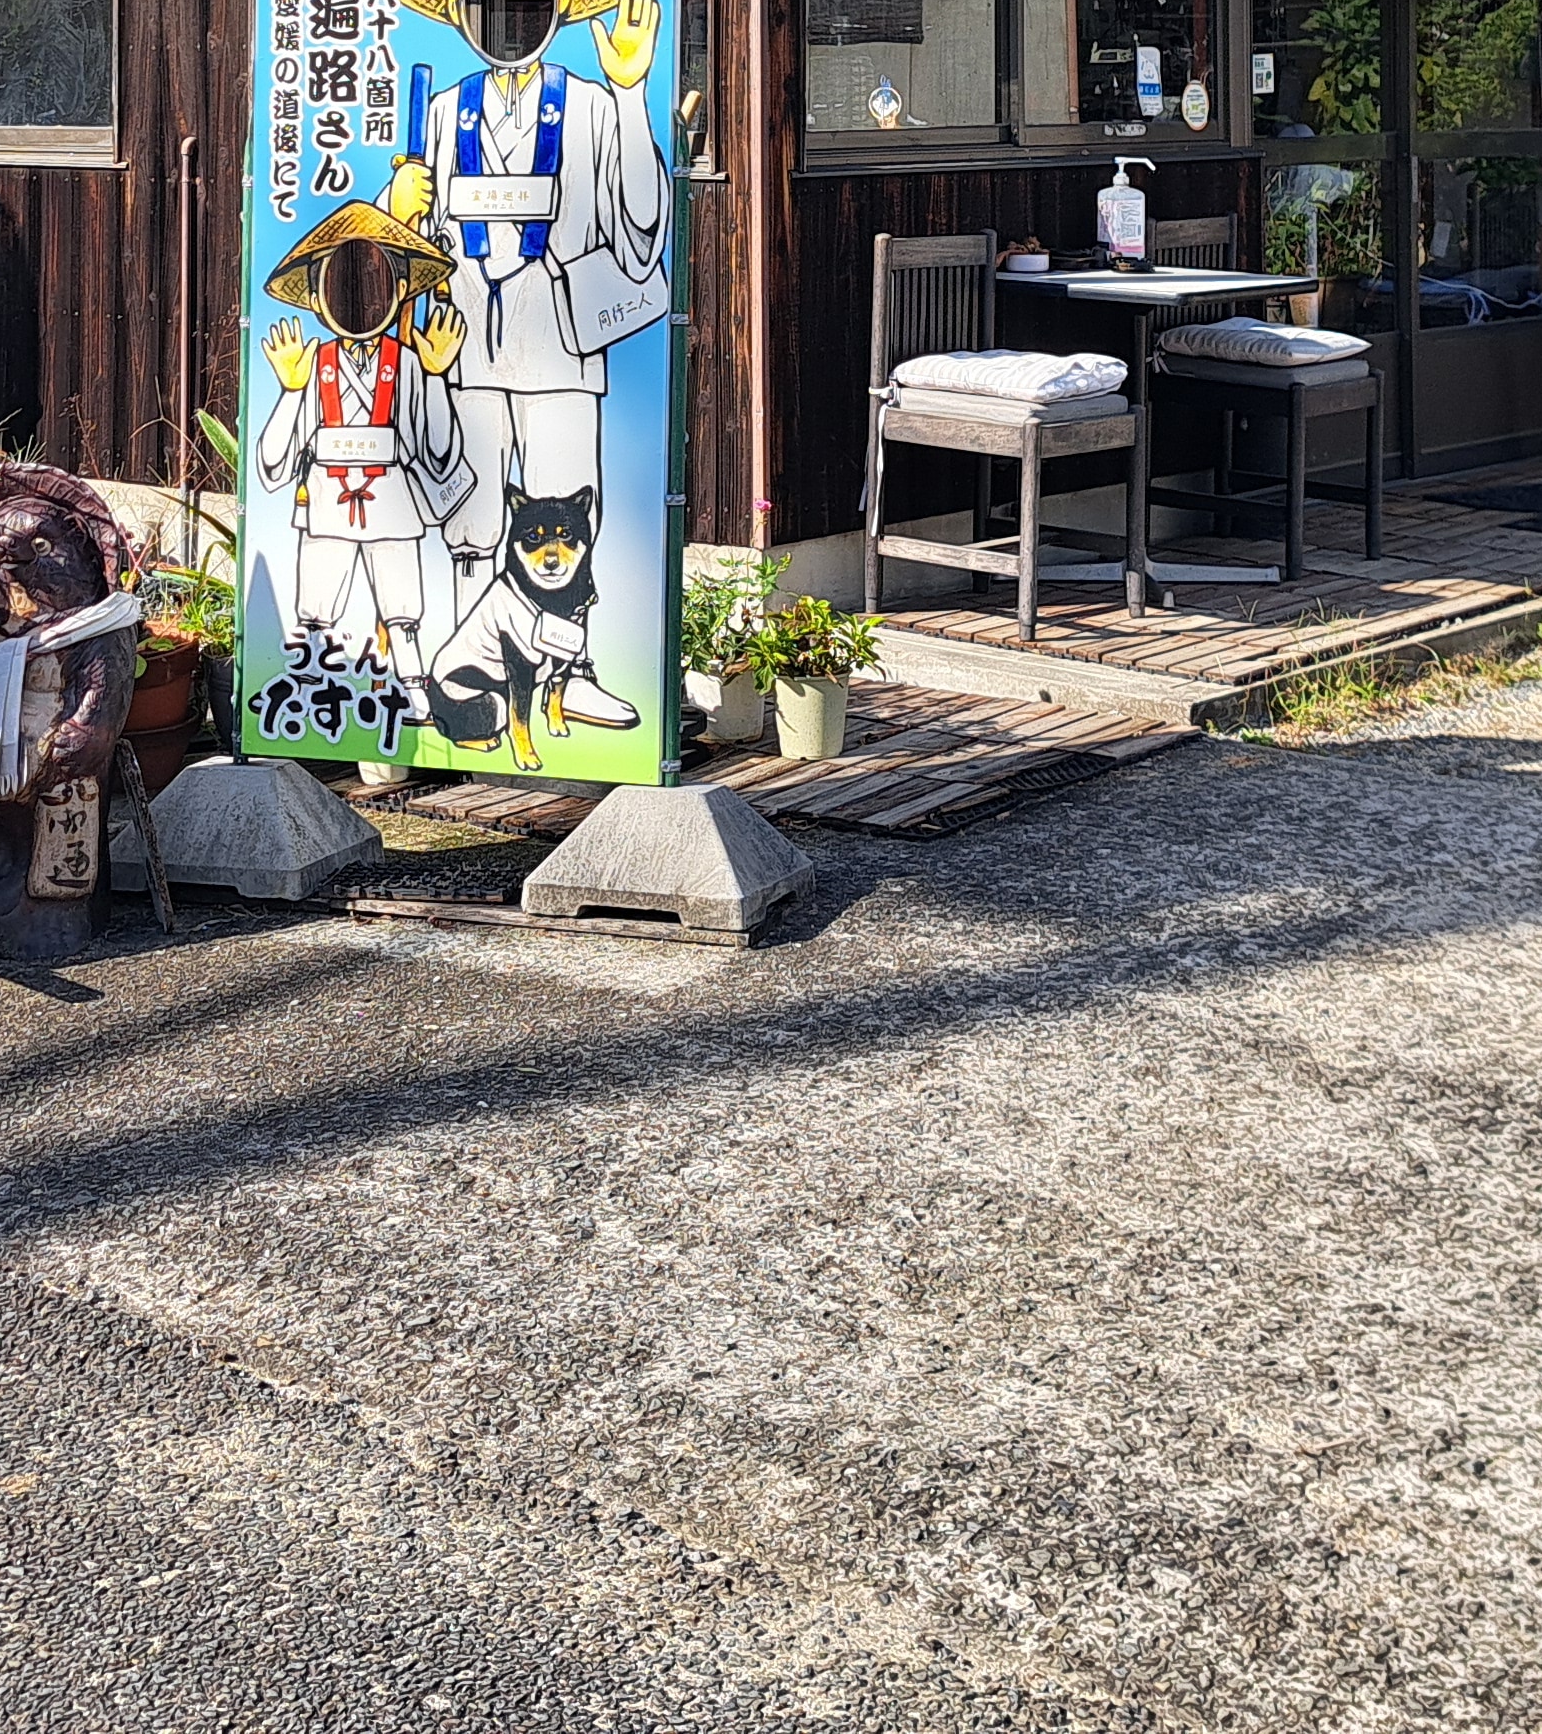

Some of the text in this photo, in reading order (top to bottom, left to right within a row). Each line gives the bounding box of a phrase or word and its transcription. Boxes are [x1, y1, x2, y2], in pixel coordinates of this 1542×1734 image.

[598, 290, 653, 331] 同行二人
[284, 632, 389, 676] うどん
[263, 677, 411, 750] たすけ
